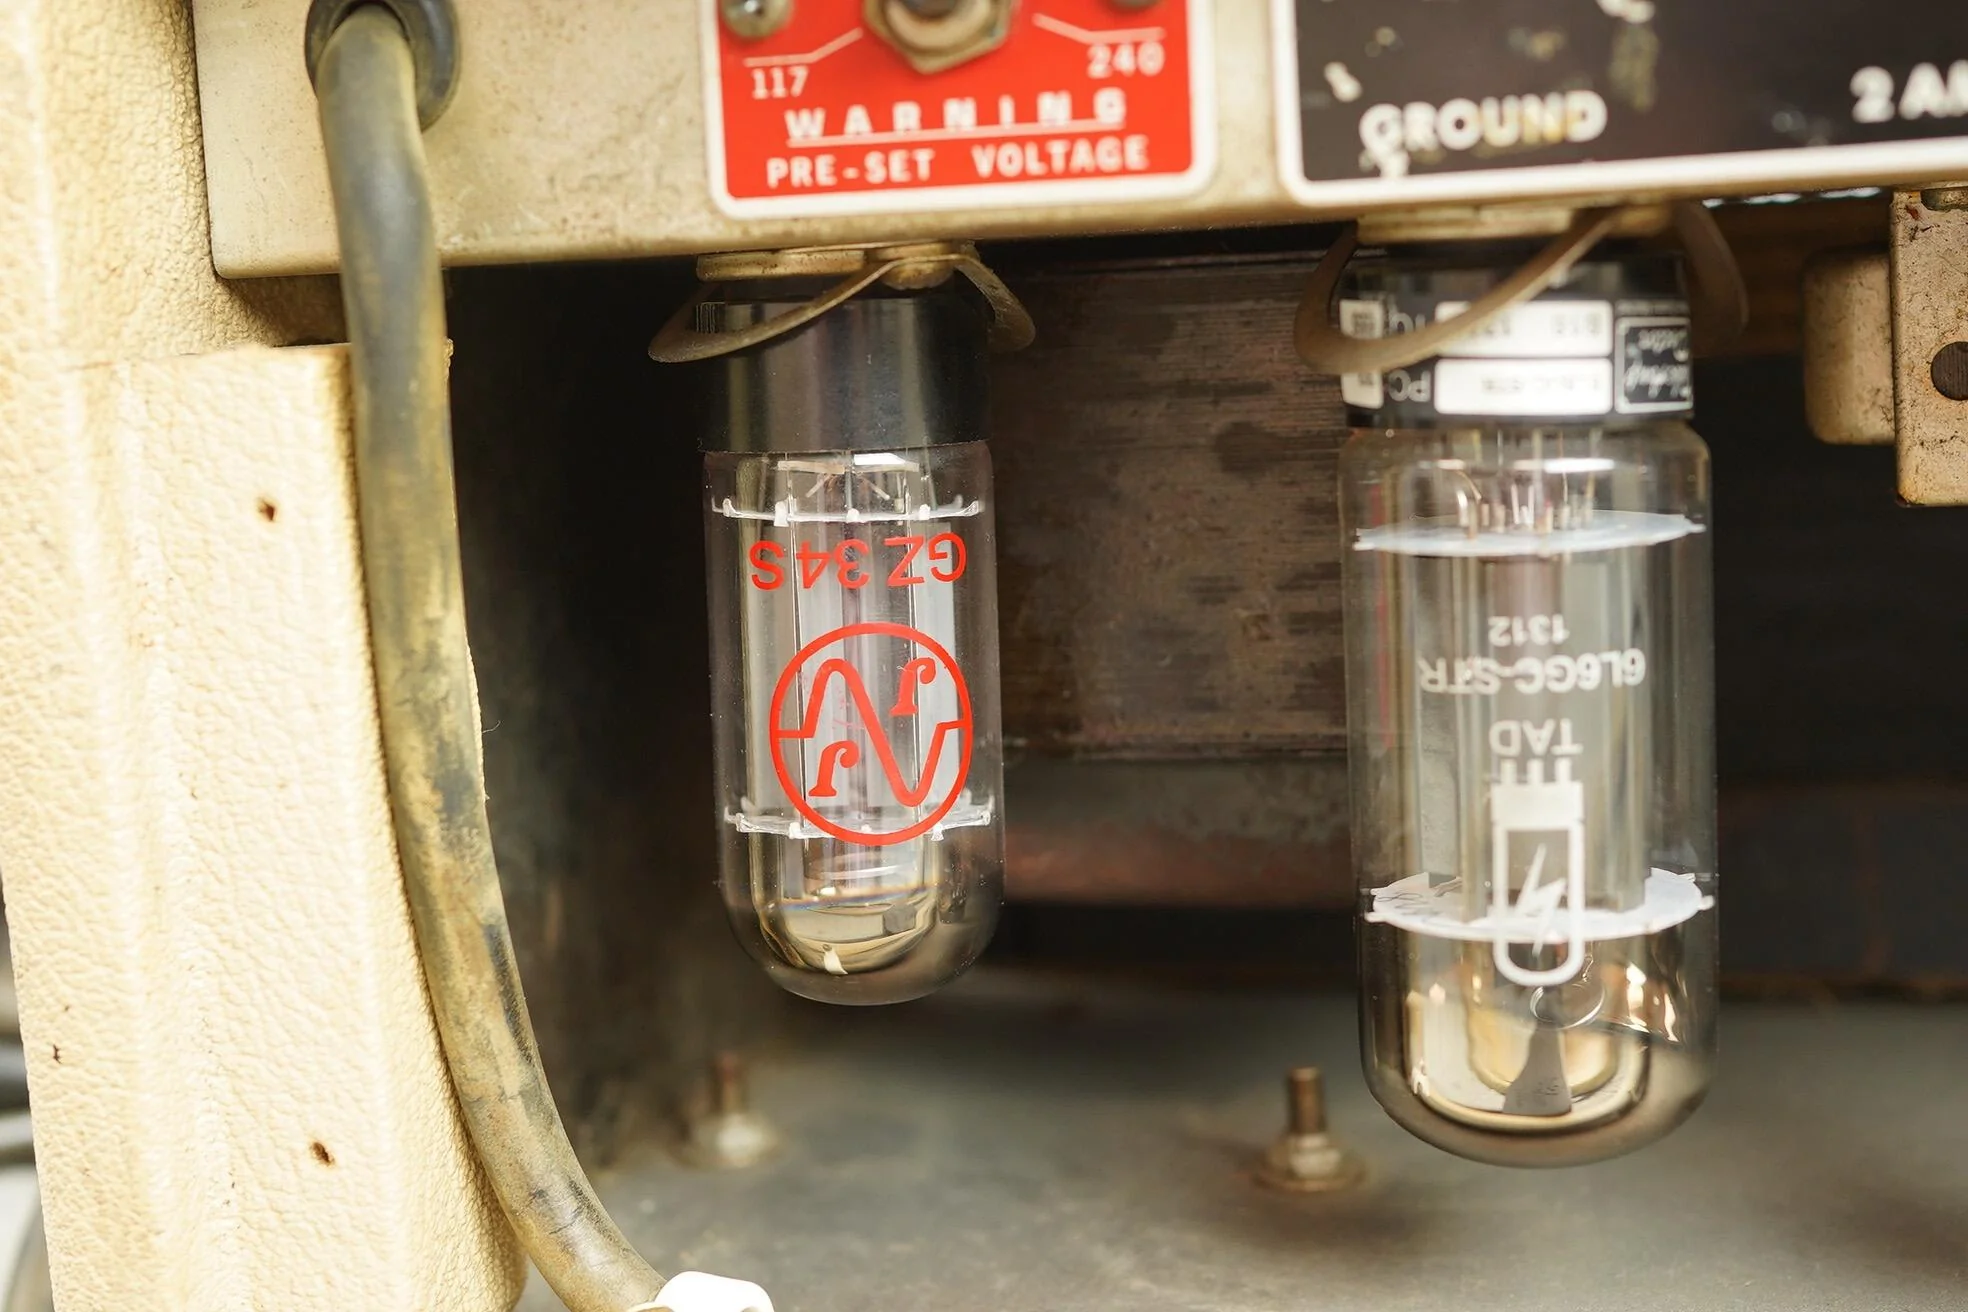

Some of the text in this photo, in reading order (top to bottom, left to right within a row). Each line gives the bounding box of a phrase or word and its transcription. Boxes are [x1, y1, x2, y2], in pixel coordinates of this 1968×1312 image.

[752, 66, 809, 99] 117
[1086, 41, 1165, 78] 240
[784, 87, 1127, 139] WARNING
[1850, 65, 1896, 123] 2
[1359, 90, 1607, 152] GROUND
[766, 135, 1150, 188] PRE-SET VOLTAGE
[749, 532, 968, 590] GZ 34S
[1487, 614, 1571, 647] 1312
[1417, 648, 1647, 695] 6L6GC-STR
[1488, 718, 1584, 757] TAD
